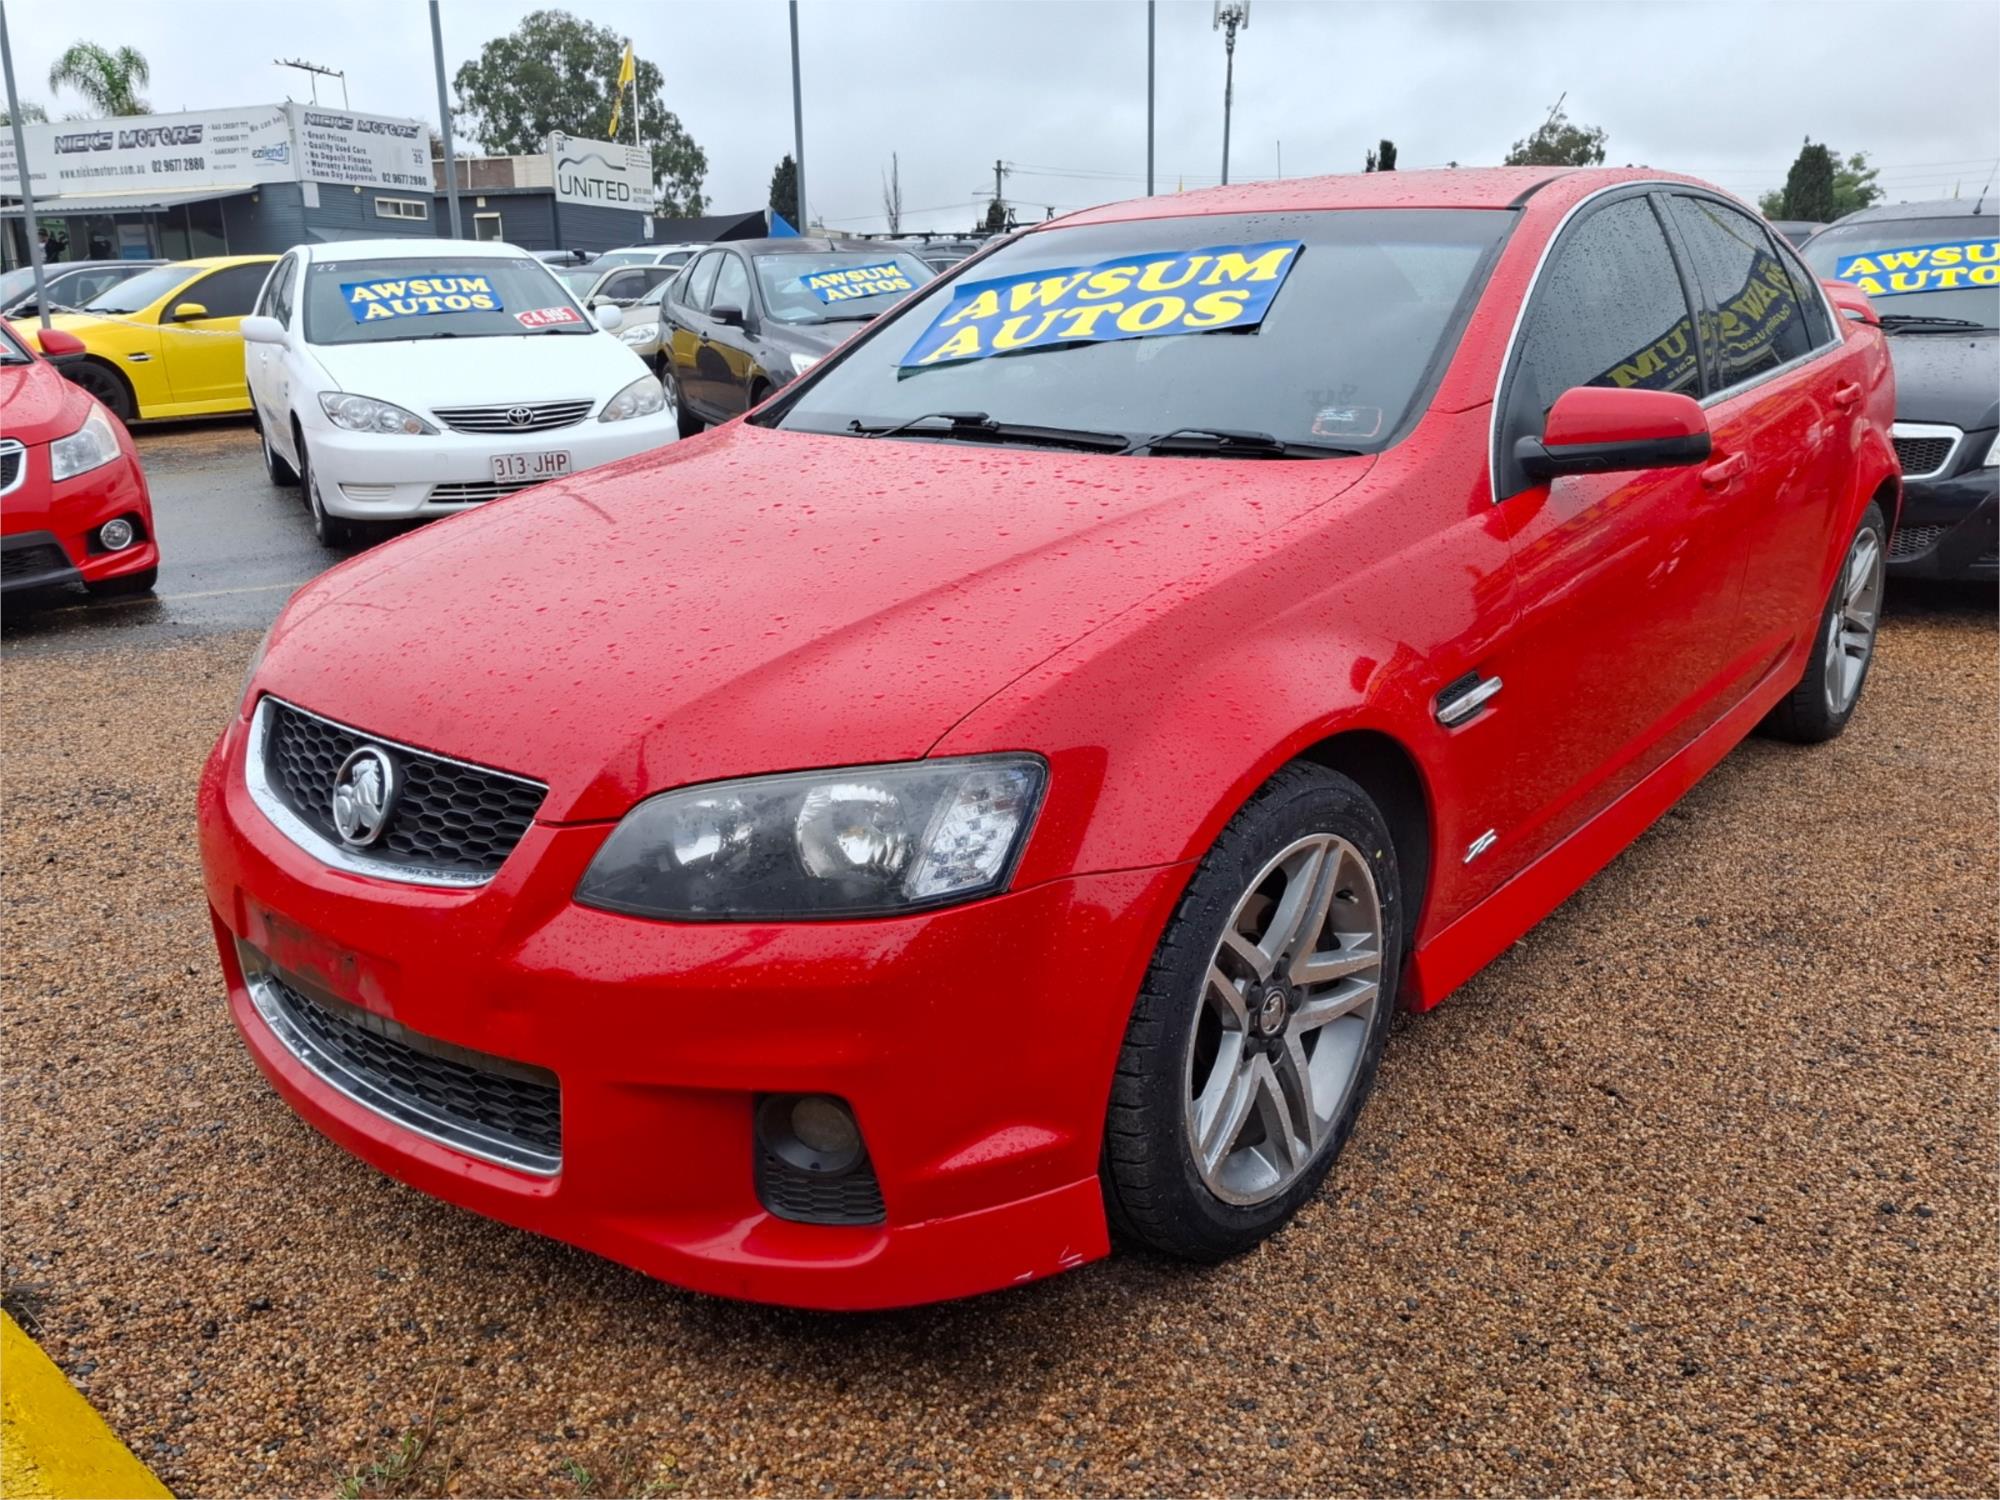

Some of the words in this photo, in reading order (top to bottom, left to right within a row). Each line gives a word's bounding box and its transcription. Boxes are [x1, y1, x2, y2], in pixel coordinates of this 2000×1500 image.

[55, 130, 113, 154] NICK'S
[118, 124, 203, 149] MOTORS
[357, 120, 419, 138] MOTORS
[152, 159, 162, 173] 02
[183, 157, 205, 171] 2880
[558, 173, 629, 201] UNITED
[351, 277, 492, 303] AWSUM
[809, 265, 903, 289] AWSUM
[825, 278, 912, 301] AUTOS
[938, 247, 1293, 327] AWSUM
[364, 294, 495, 320] AUTOS
[918, 289, 1251, 364] AUTOS
